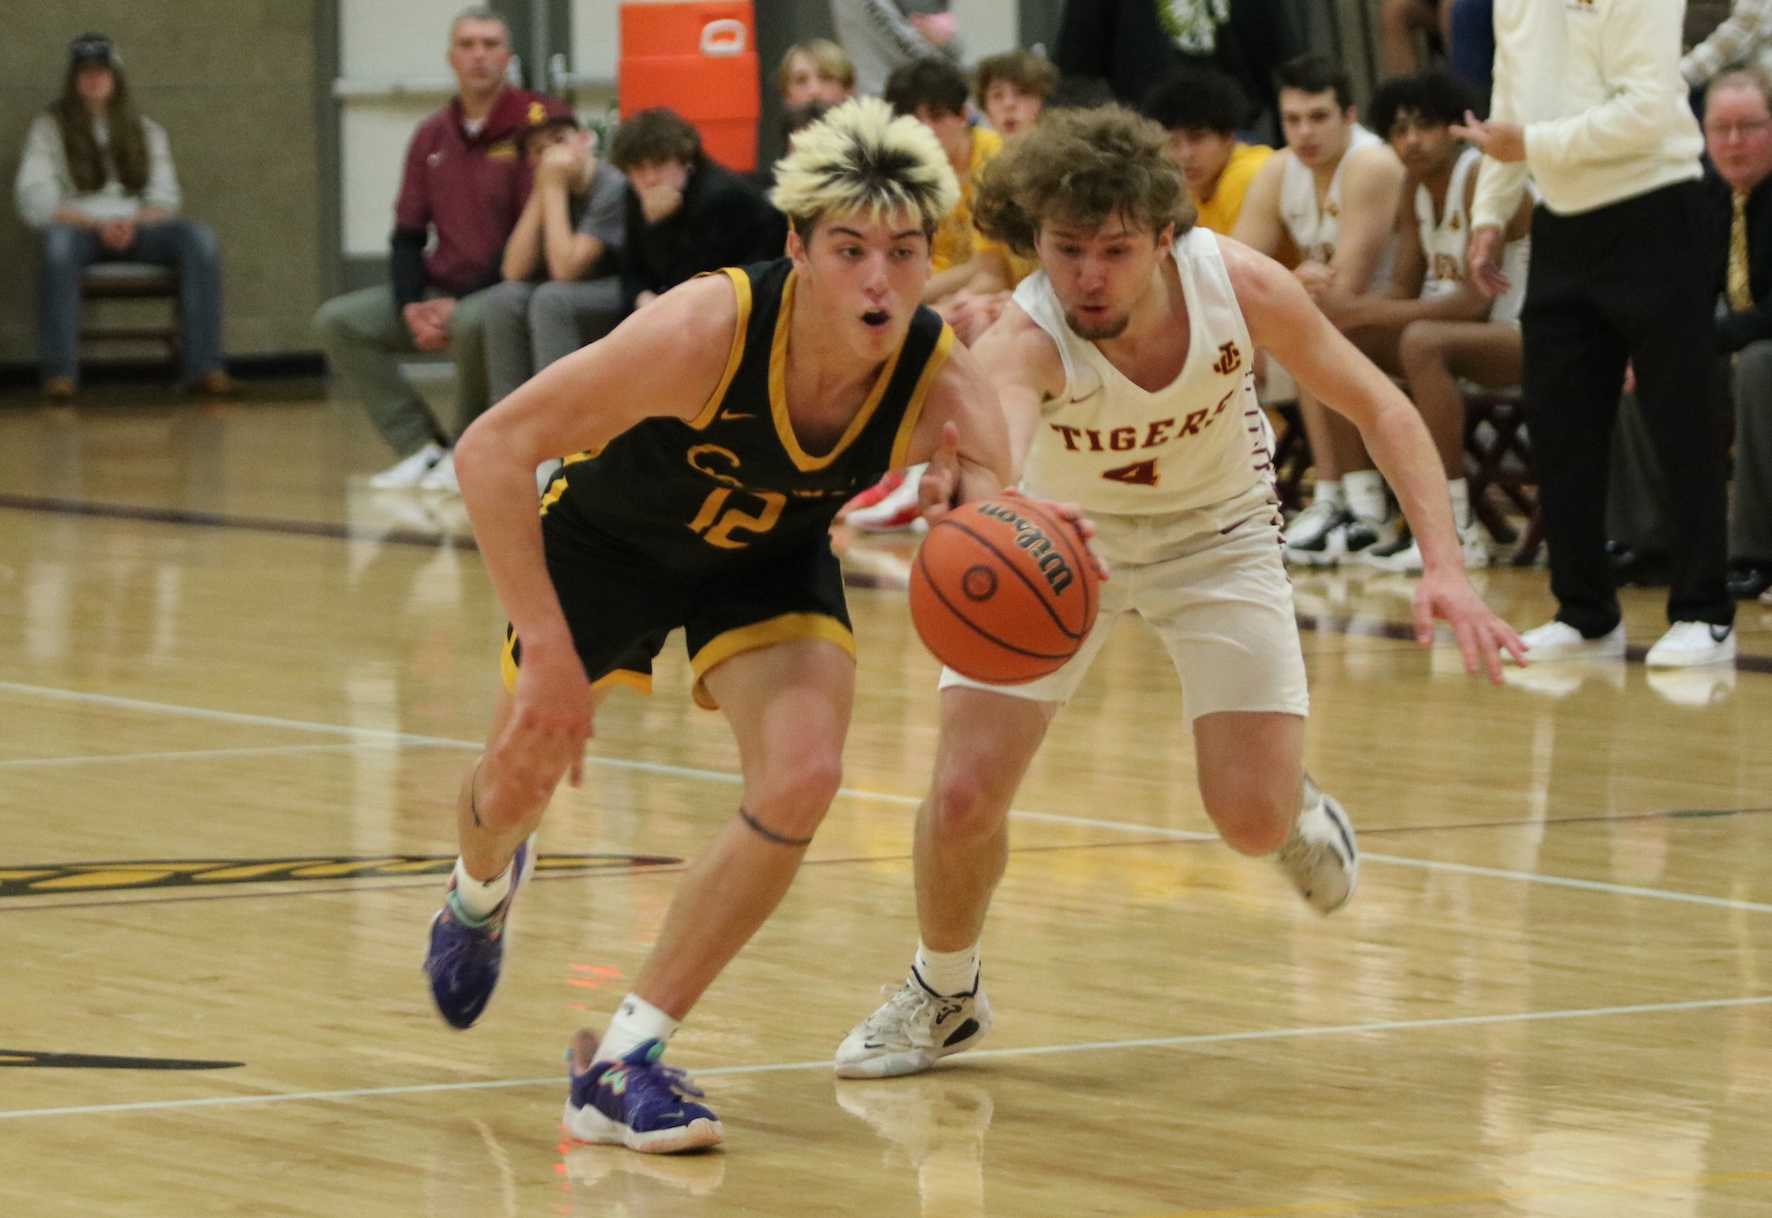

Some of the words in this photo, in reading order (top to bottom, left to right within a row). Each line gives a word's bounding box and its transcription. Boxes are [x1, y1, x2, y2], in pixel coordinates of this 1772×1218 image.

[1101, 457, 1160, 488] 4
[686, 486, 788, 549] 12
[977, 503, 1073, 597] Wilson
